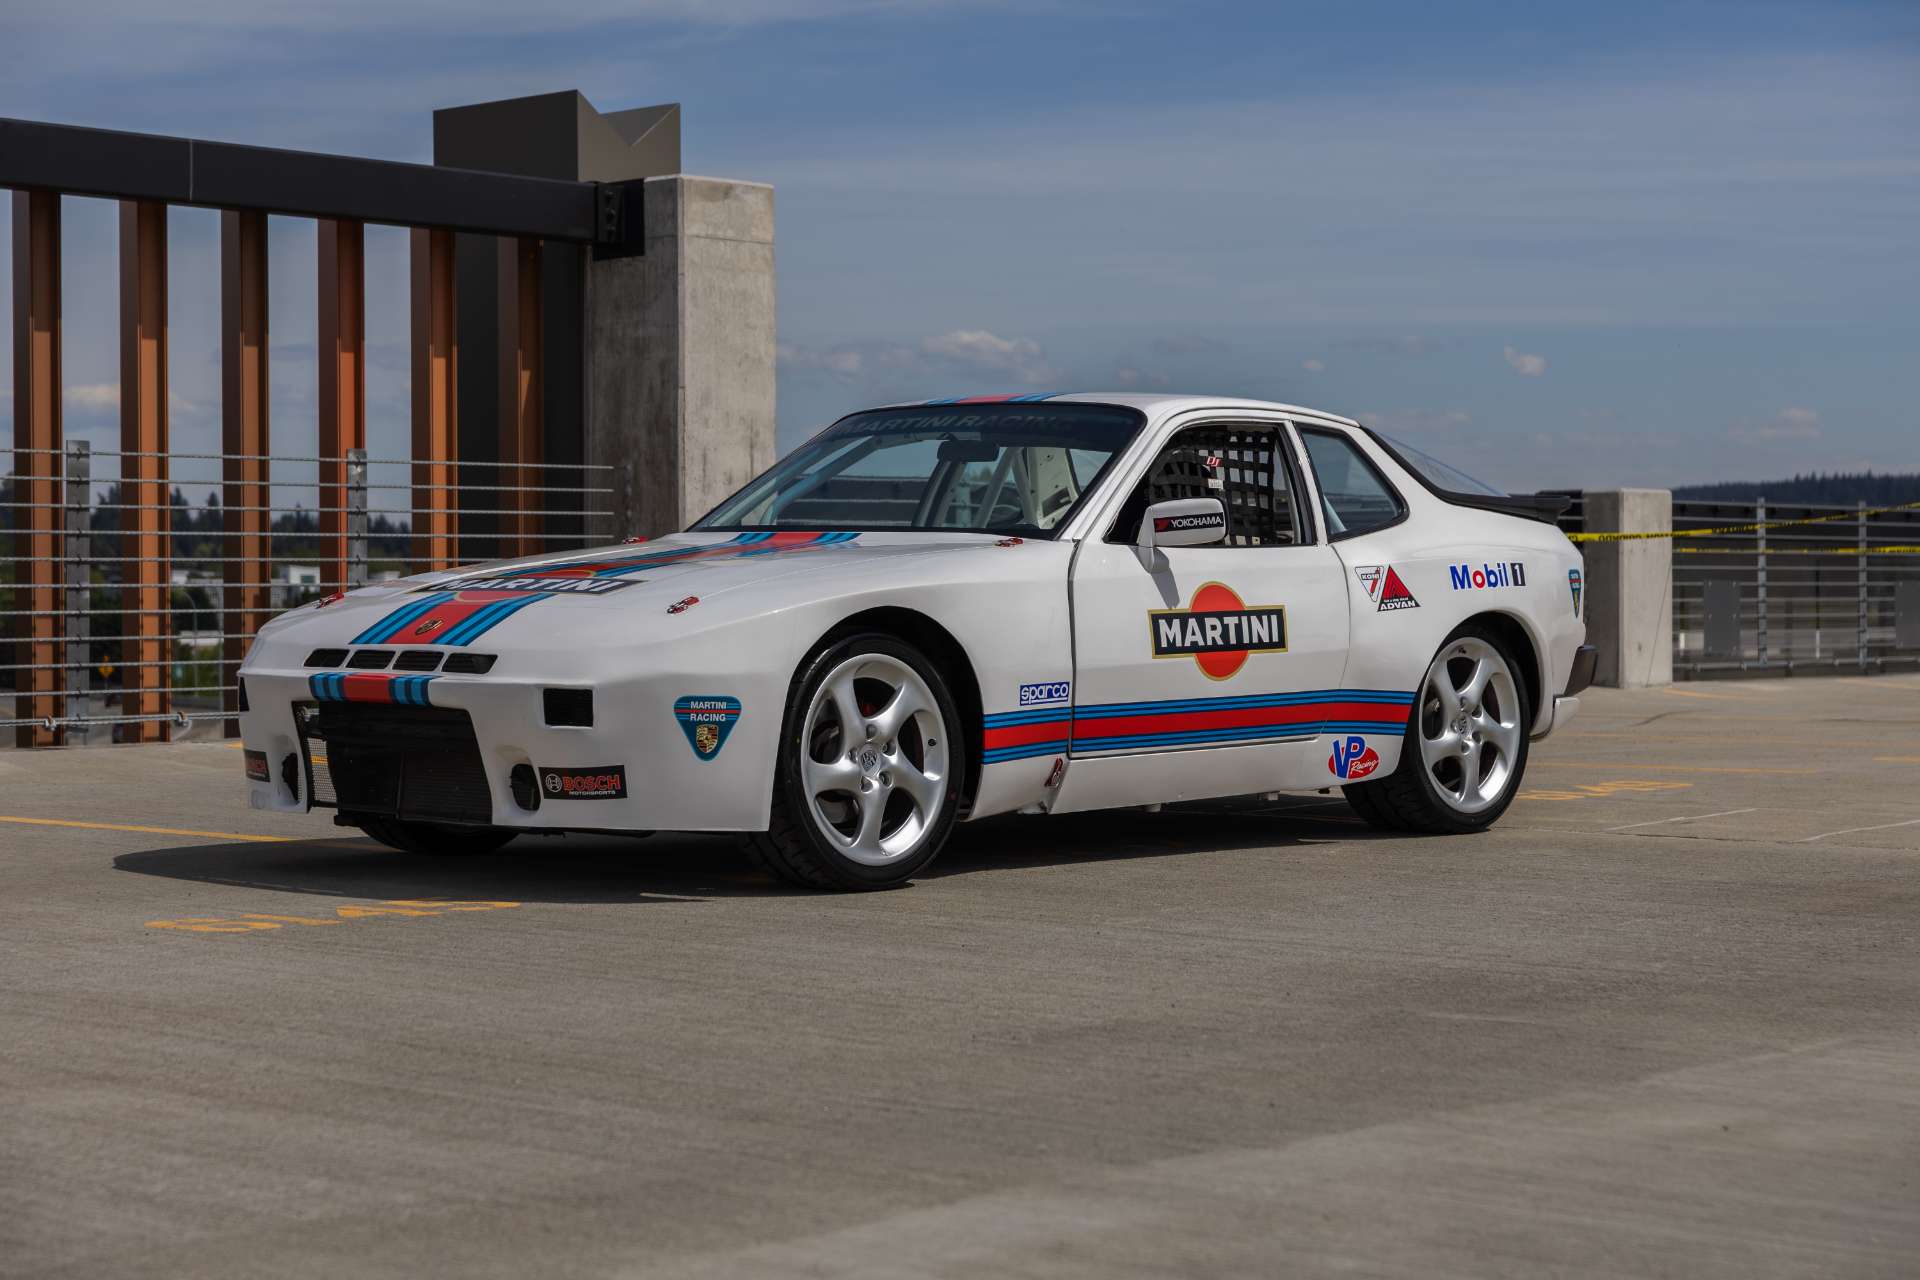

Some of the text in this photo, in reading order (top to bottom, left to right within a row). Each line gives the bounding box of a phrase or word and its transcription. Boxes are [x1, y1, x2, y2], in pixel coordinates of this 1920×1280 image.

[1171, 516, 1222, 528] YOKOHAMA
[1449, 562, 1524, 590] Mobil 1
[430, 579, 625, 592] MARTINI
[1380, 601, 1415, 610] ADVAN
[1158, 615, 1279, 647] MARTINI
[1021, 683, 1068, 704] sparco
[690, 701, 727, 709] MARTINI
[689, 713, 726, 721] RACING
[1332, 736, 1366, 778] VP
[1350, 760, 1377, 774] Racing
[562, 774, 621, 791] BOSCH
